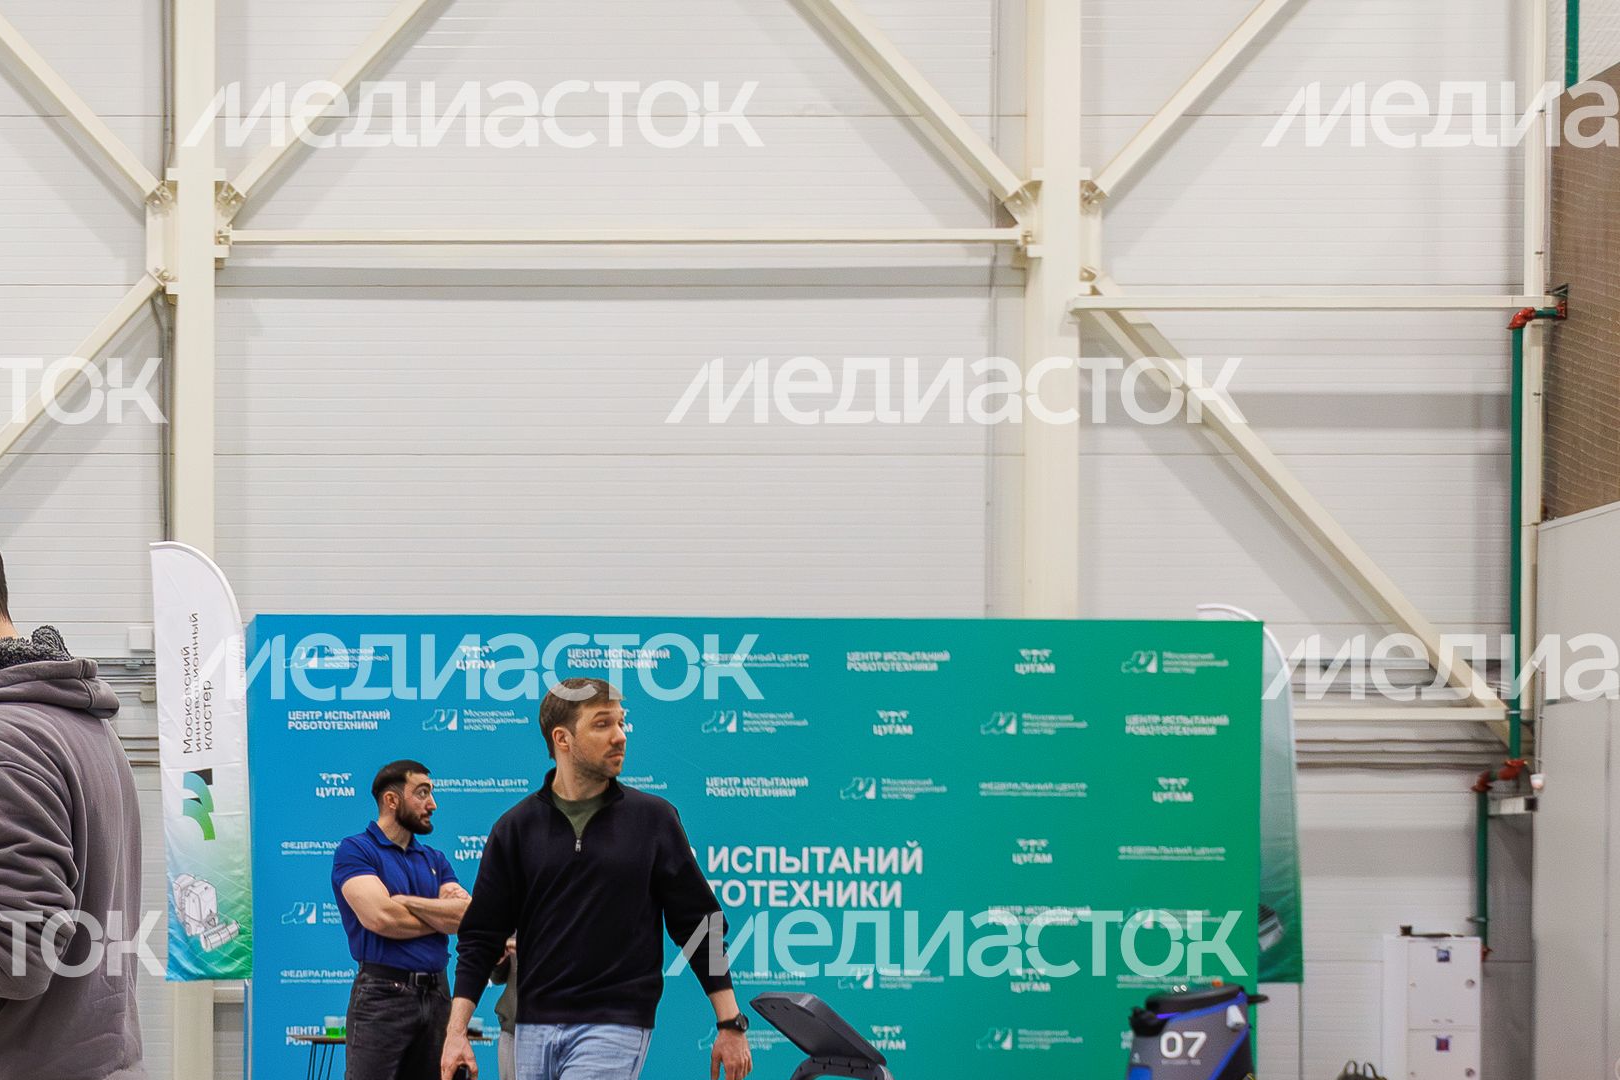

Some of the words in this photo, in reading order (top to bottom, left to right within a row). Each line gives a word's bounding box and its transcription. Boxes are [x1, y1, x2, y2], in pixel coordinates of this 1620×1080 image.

[204, 680, 214, 750] кластер
[288, 710, 322, 721] ЦЕНТР
[324, 709, 390, 720] ИСПЫТАНИЙ
[288, 721, 378, 730] РОБОТОТЕХНИКИ
[432, 778, 495, 787] ЕДЕРАЛЬНЫЙ
[706, 777, 741, 787] ЦЕНТР
[743, 776, 809, 787] ИСПЫТАНИЙ
[316, 786, 355, 798] ЦУГАМ
[706, 787, 796, 797] РОБОТОТЕХНИКИ
[281, 841, 341, 850] ФЕДЕРАЛЬН
[707, 840, 923, 875] ИСПЫТАНИЙ
[709, 879, 902, 908] ТОТЕХНИКИ
[286, 1026, 319, 1036] ЦЕНТР
[1160, 1031, 1207, 1058] 07
